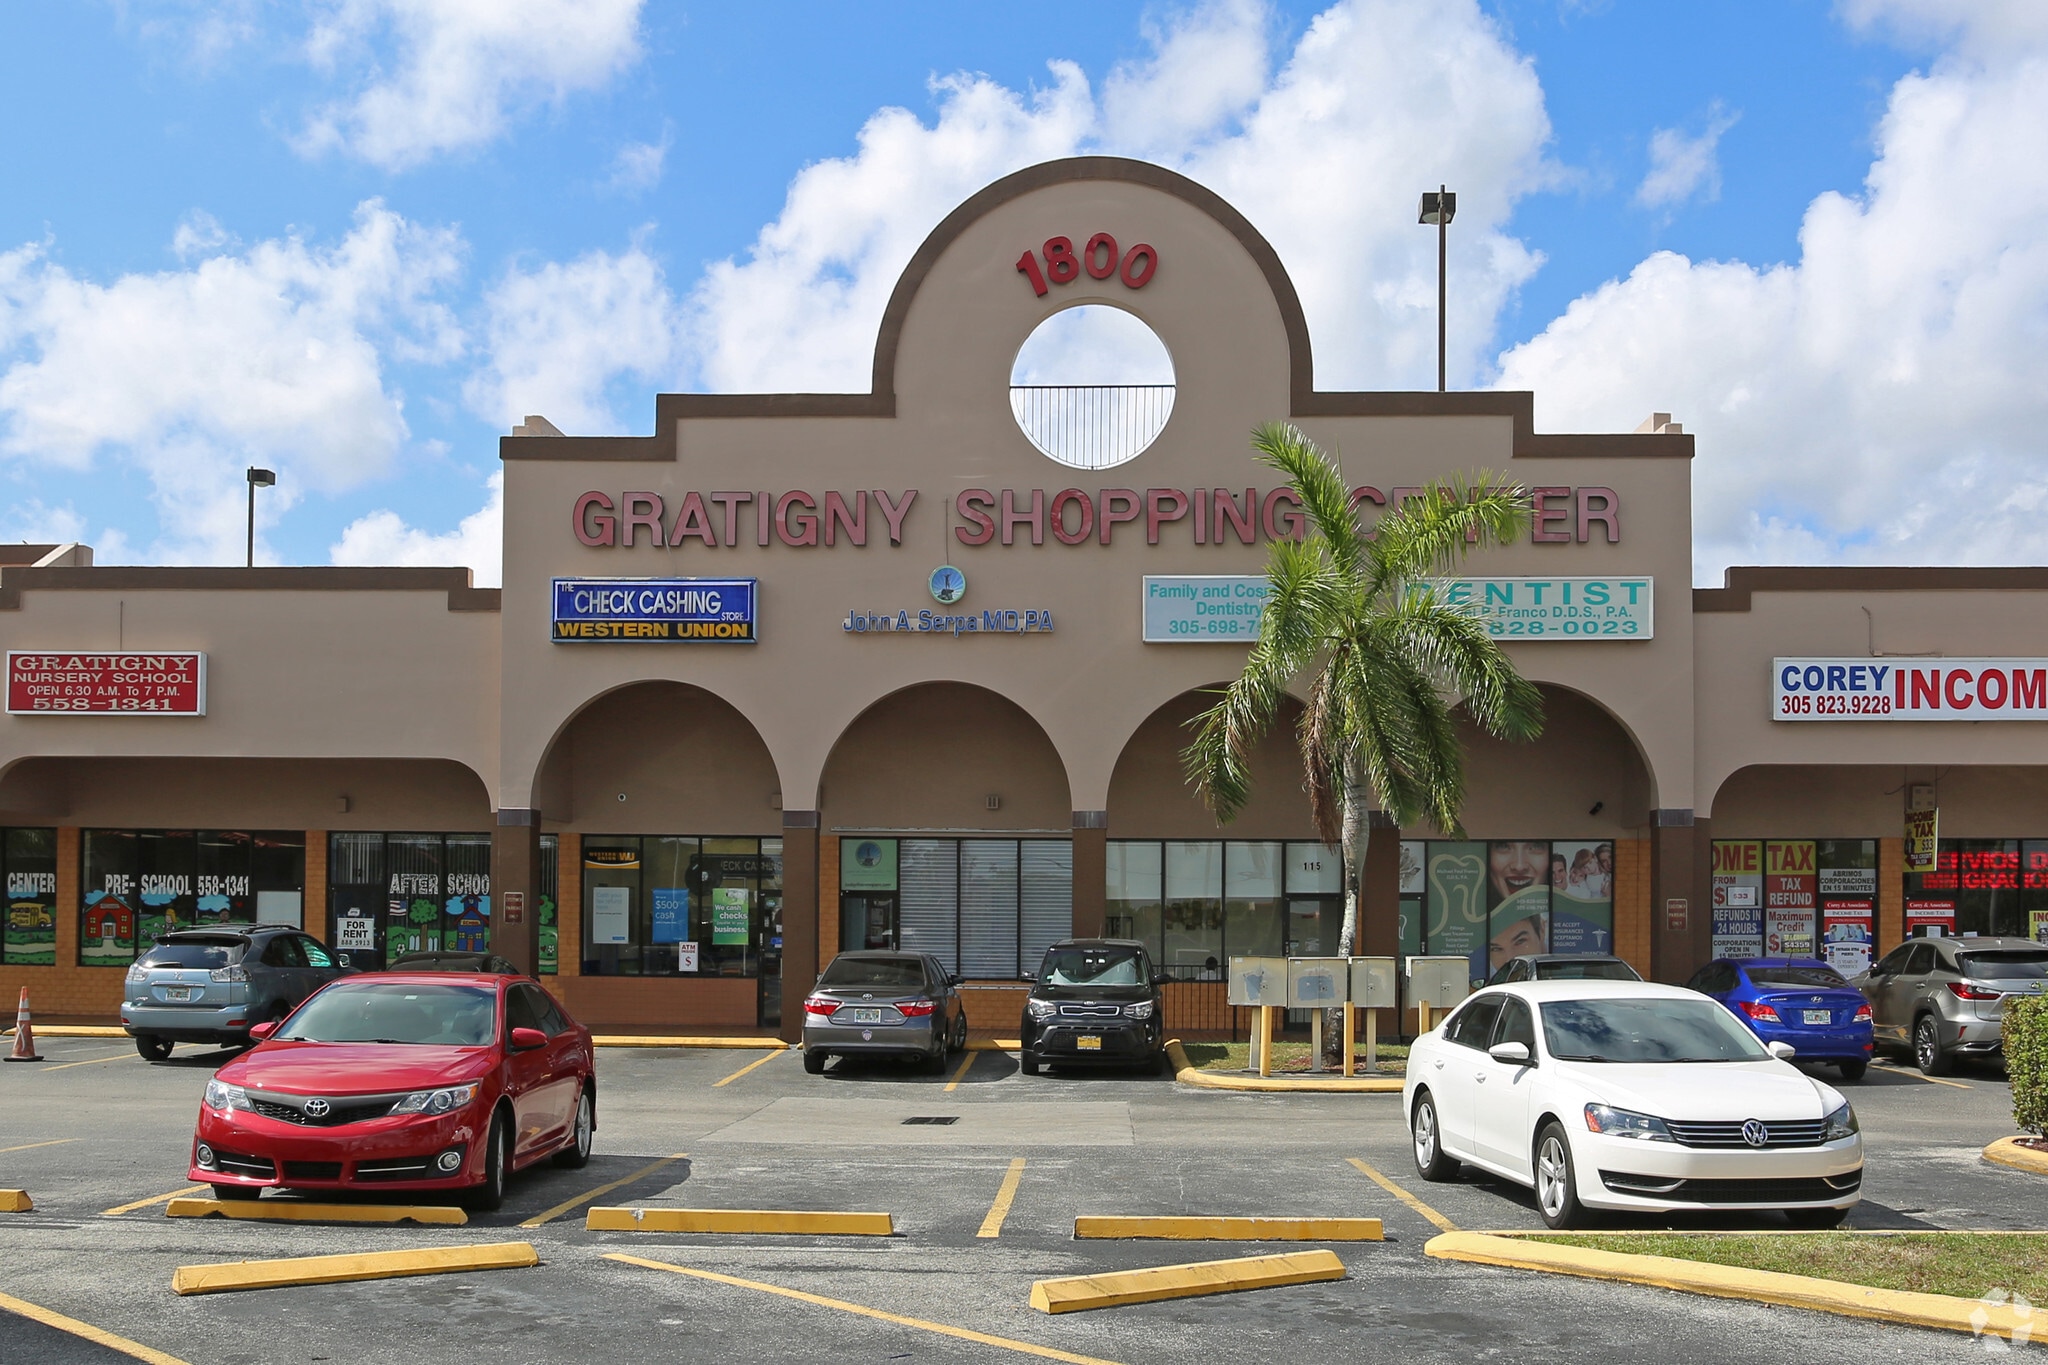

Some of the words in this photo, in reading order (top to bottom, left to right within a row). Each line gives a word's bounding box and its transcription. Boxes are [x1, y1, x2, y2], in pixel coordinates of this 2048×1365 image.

[1016, 231, 1158, 298] 1800
[572, 490, 919, 547] GRATIGNY
[954, 487, 1306, 546] SHOPPING
[561, 583, 574, 593] THE
[1150, 583, 1198, 600] Family
[1202, 583, 1231, 598] and
[574, 590, 636, 614] CHECK
[639, 590, 722, 615] CASHING
[1196, 601, 1262, 618] Dentistry
[1498, 606, 1547, 618] Franco
[1606, 606, 1632, 618] P.A.
[721, 612, 745, 622] STORE
[843, 609, 891, 633] John
[895, 609, 915, 632] A.
[918, 609, 978, 638] Serpa
[558, 622, 669, 638] WESTERN
[677, 622, 748, 638] UNION
[15, 656, 194, 671] GRATIGNY
[14, 673, 103, 683] NURSERY
[112, 673, 193, 683] SCHOOL
[27, 685, 60, 696] OPEN
[65, 685, 92, 696] 6.30
[96, 685, 121, 696] A.M.
[126, 685, 140, 696] To
[144, 686, 152, 696] 7
[157, 686, 180, 696] P.M.
[1781, 666, 1890, 691] COREY
[1895, 668, 2048, 710] INCOM
[33, 697, 173, 711] 558-1341
[1782, 695, 1811, 714] 305
[1816, 695, 1891, 714] 823.9228
[1914, 822, 1934, 838] TAX
[1767, 844, 1813, 871] TAX
[1304, 861, 1321, 871] 115
[1833, 870, 1862, 878] ABRIMOS
[7, 872, 56, 893] CENTER
[105, 874, 136, 895] PRE-
[141, 874, 192, 896] SCHOOL
[197, 875, 249, 897] 558-1341
[389, 873, 439, 895] AFTER
[1713, 876, 1736, 885] FROM
[1780, 878, 1801, 891] TAX
[1820, 877, 1875, 885] CORPORACIONES
[1843, 884, 1873, 892] MINUTES
[1713, 886, 1726, 906] $
[1769, 893, 1812, 906] REFUND
[655, 900, 679, 911] $500
[655, 910, 675, 919] cash
[719, 911, 748, 920] checks
[1713, 909, 1751, 921] REFUNDS
[1752, 909, 1762, 921] IN
[1768, 911, 1813, 922] Maximum
[2033, 912, 2048, 922] IN
[346, 920, 366, 930] FOR
[1717, 922, 1728, 934] 24
[1729, 922, 1758, 934] HOURS
[1776, 922, 1805, 932] Credit
[343, 929, 369, 939] RENT
[1713, 939, 1761, 947] CORPORATIONS
[1768, 933, 1780, 954] $
